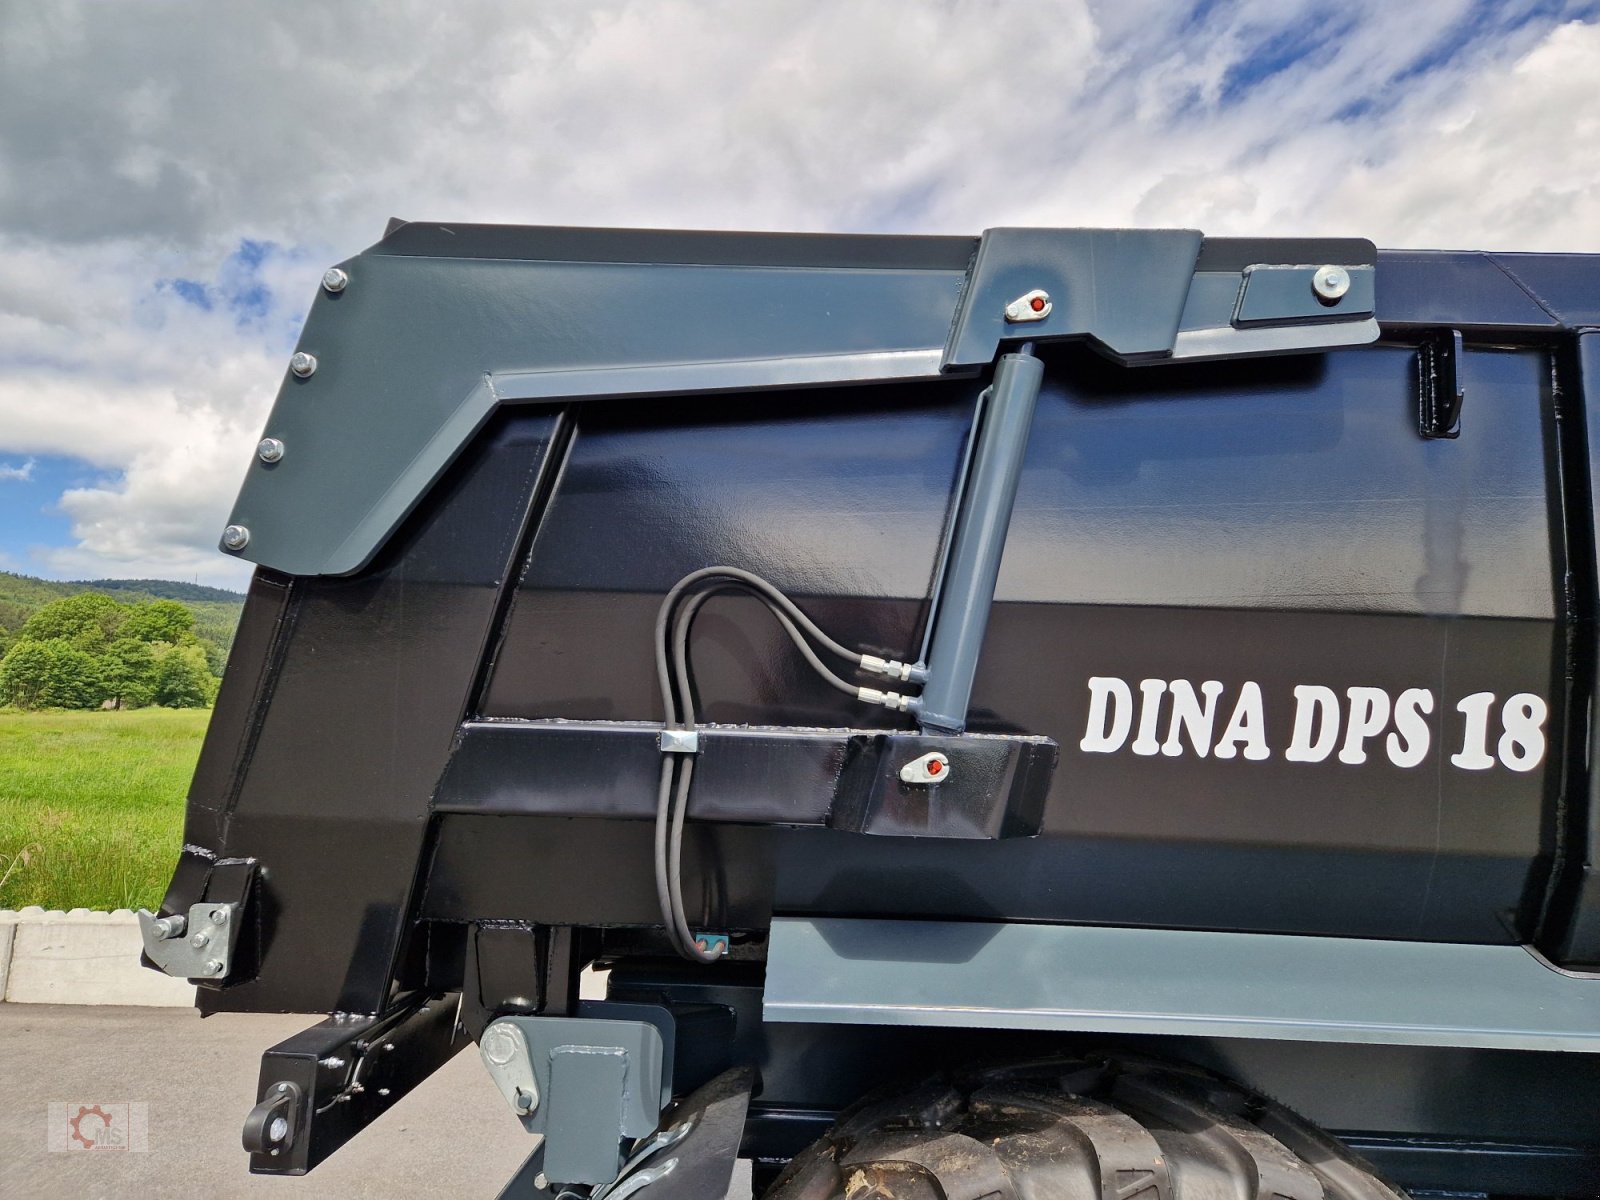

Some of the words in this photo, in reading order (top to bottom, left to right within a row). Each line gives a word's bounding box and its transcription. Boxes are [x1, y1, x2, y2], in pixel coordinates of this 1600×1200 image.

[1079, 676, 1271, 761] DINA
[1285, 684, 1434, 768] DPS
[1450, 691, 1548, 772] 18
